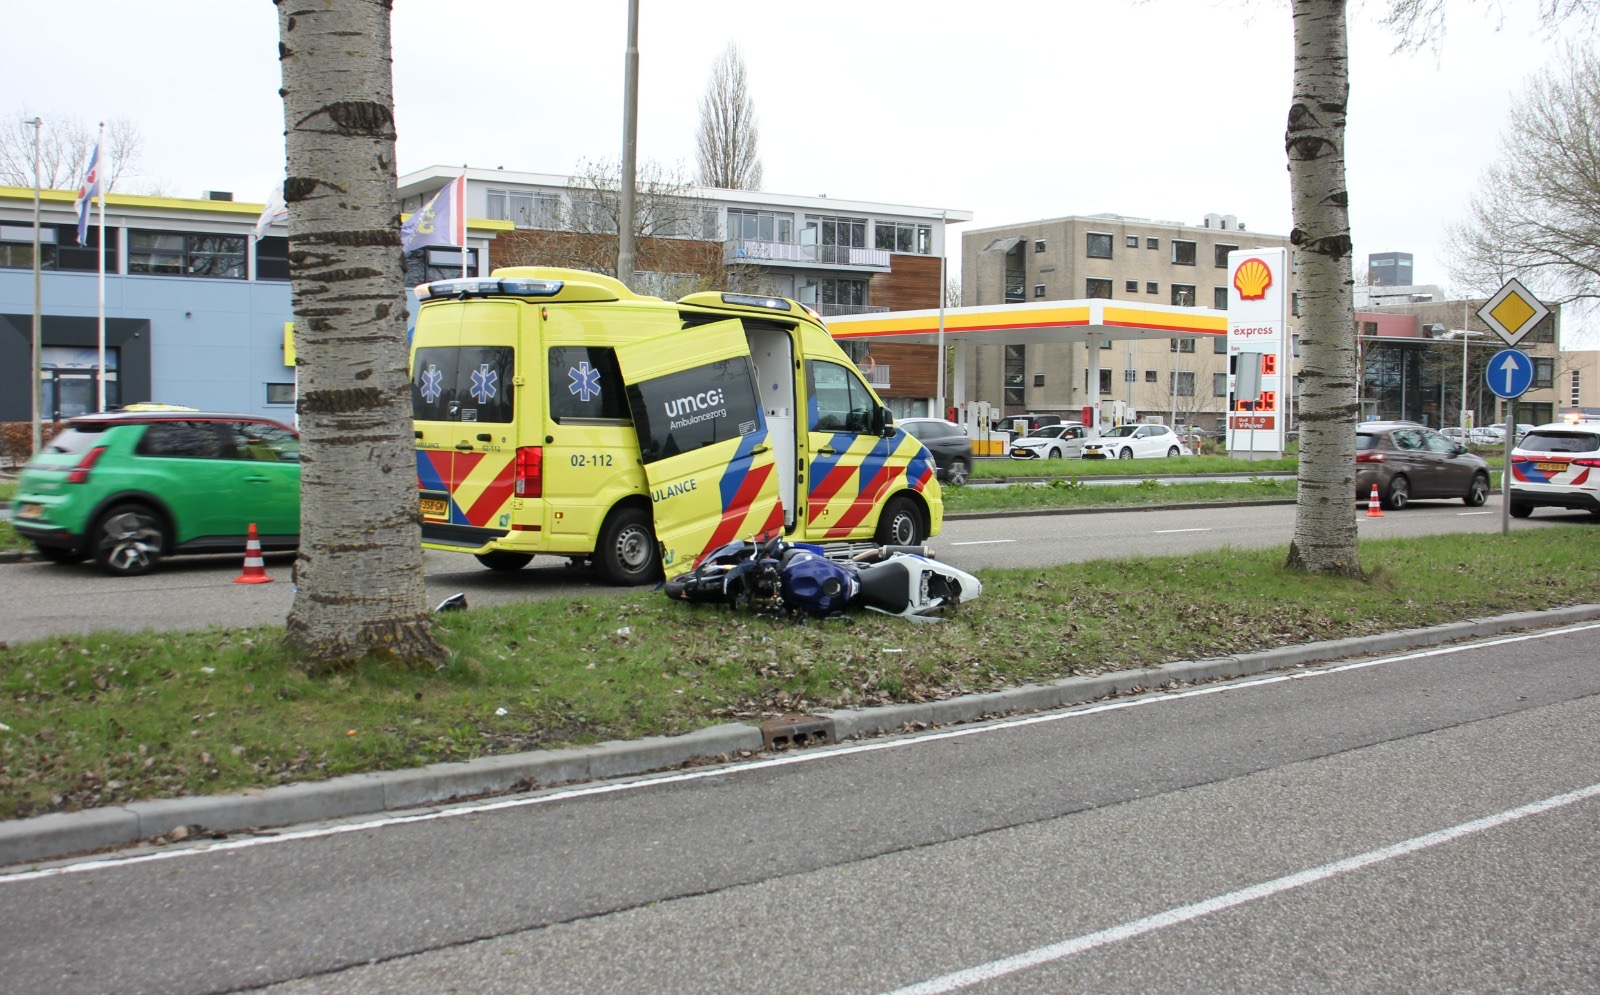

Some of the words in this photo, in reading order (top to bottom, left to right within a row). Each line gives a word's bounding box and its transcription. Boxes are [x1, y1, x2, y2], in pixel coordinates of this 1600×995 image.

[1233, 327, 1273, 338] express
[670, 408, 727, 431] Ambulancezorg
[571, 454, 613, 467] 02-112
